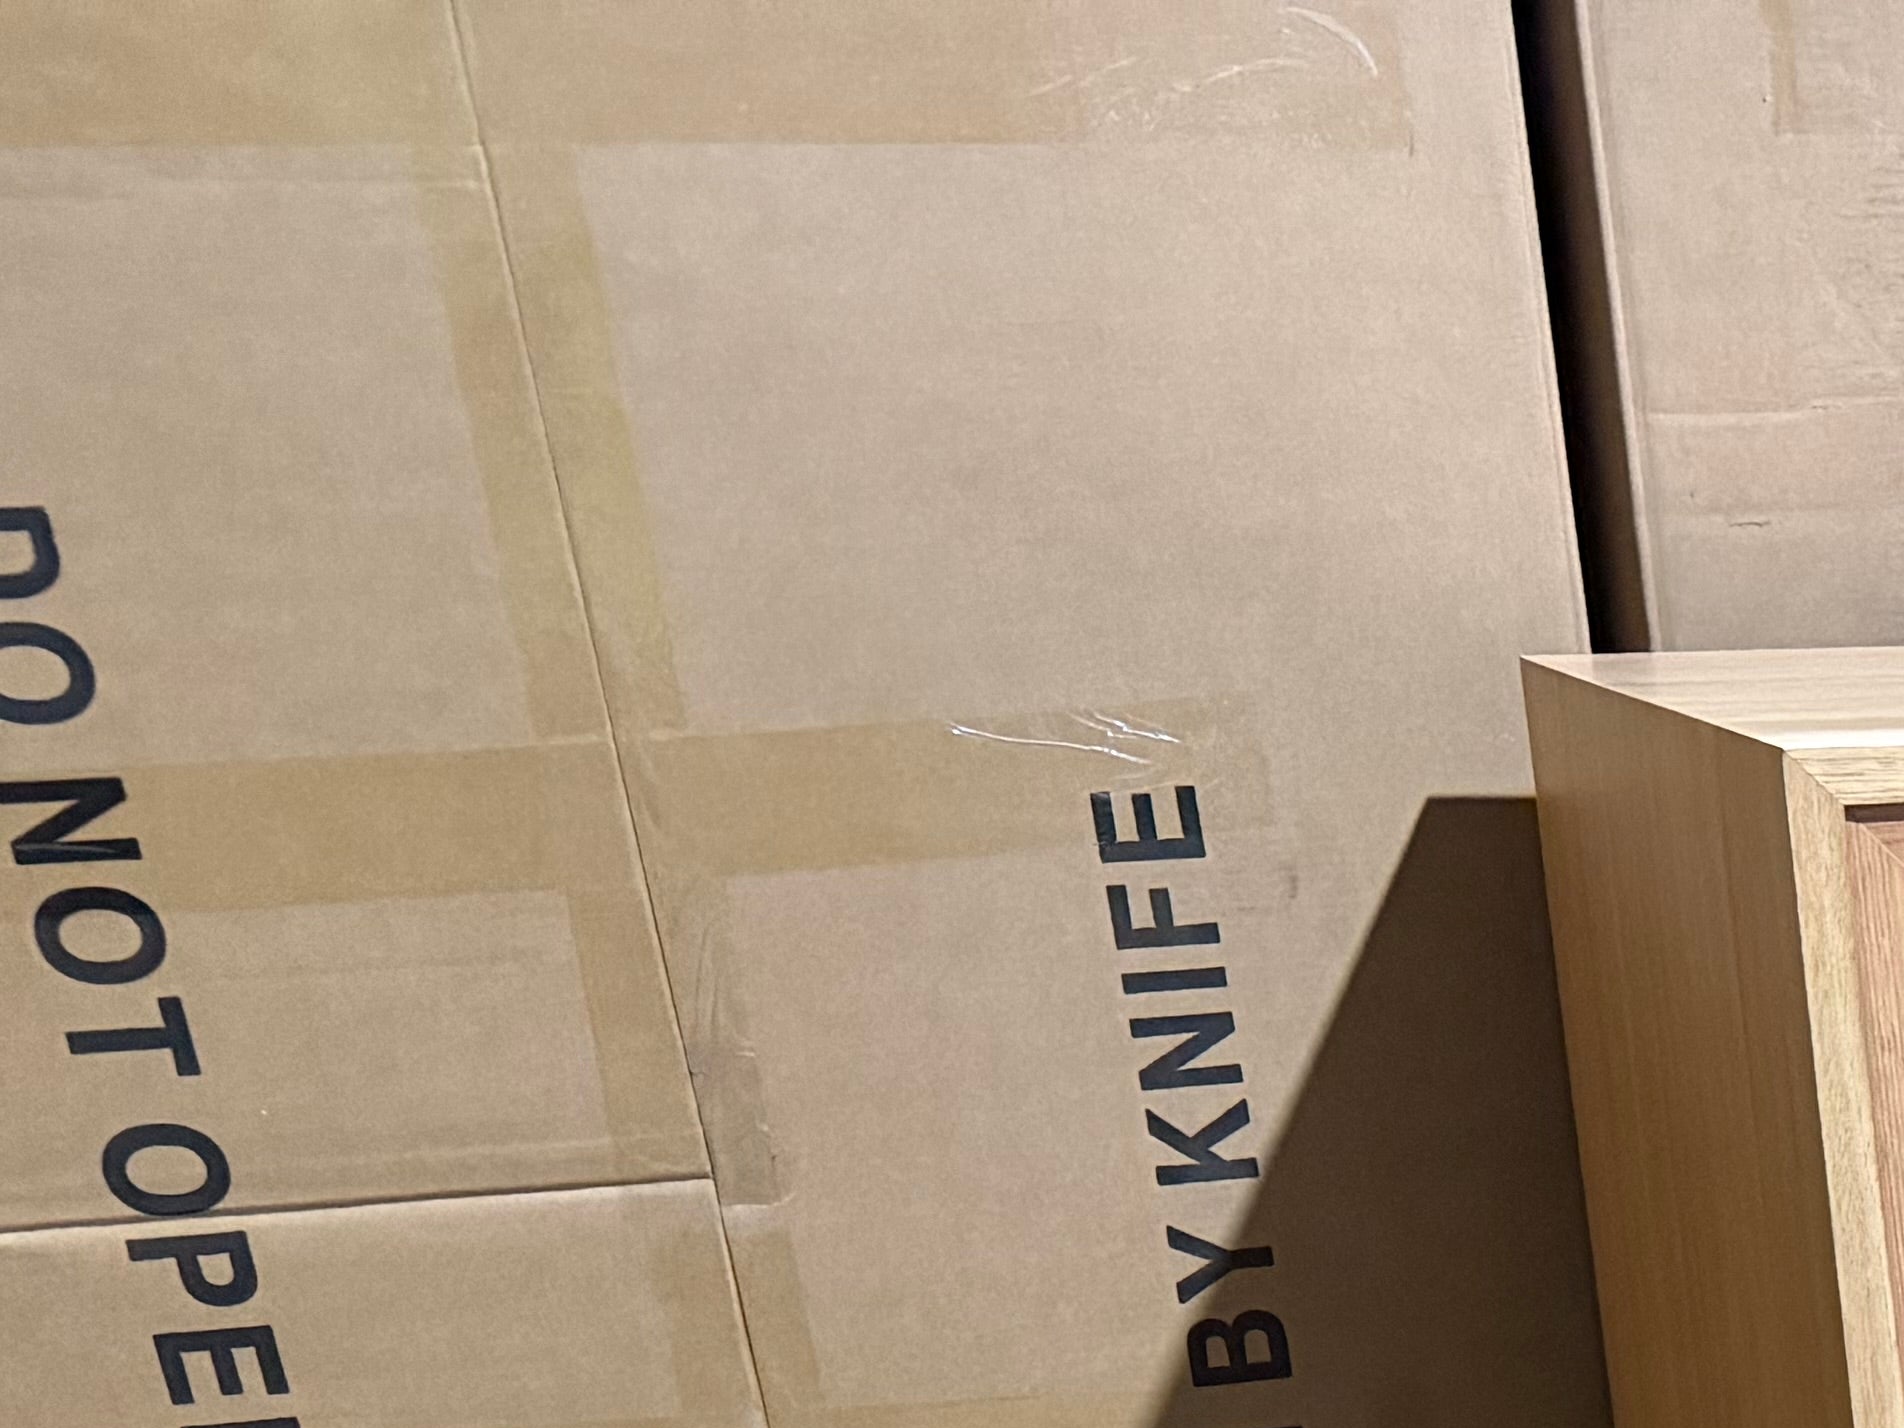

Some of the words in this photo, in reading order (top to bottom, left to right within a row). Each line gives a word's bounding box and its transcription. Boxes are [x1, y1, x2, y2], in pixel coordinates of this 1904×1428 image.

[0, 777, 202, 1076] NOT
[1090, 785, 1260, 1186] KNIFE
[1166, 1224, 1292, 1387] BY
